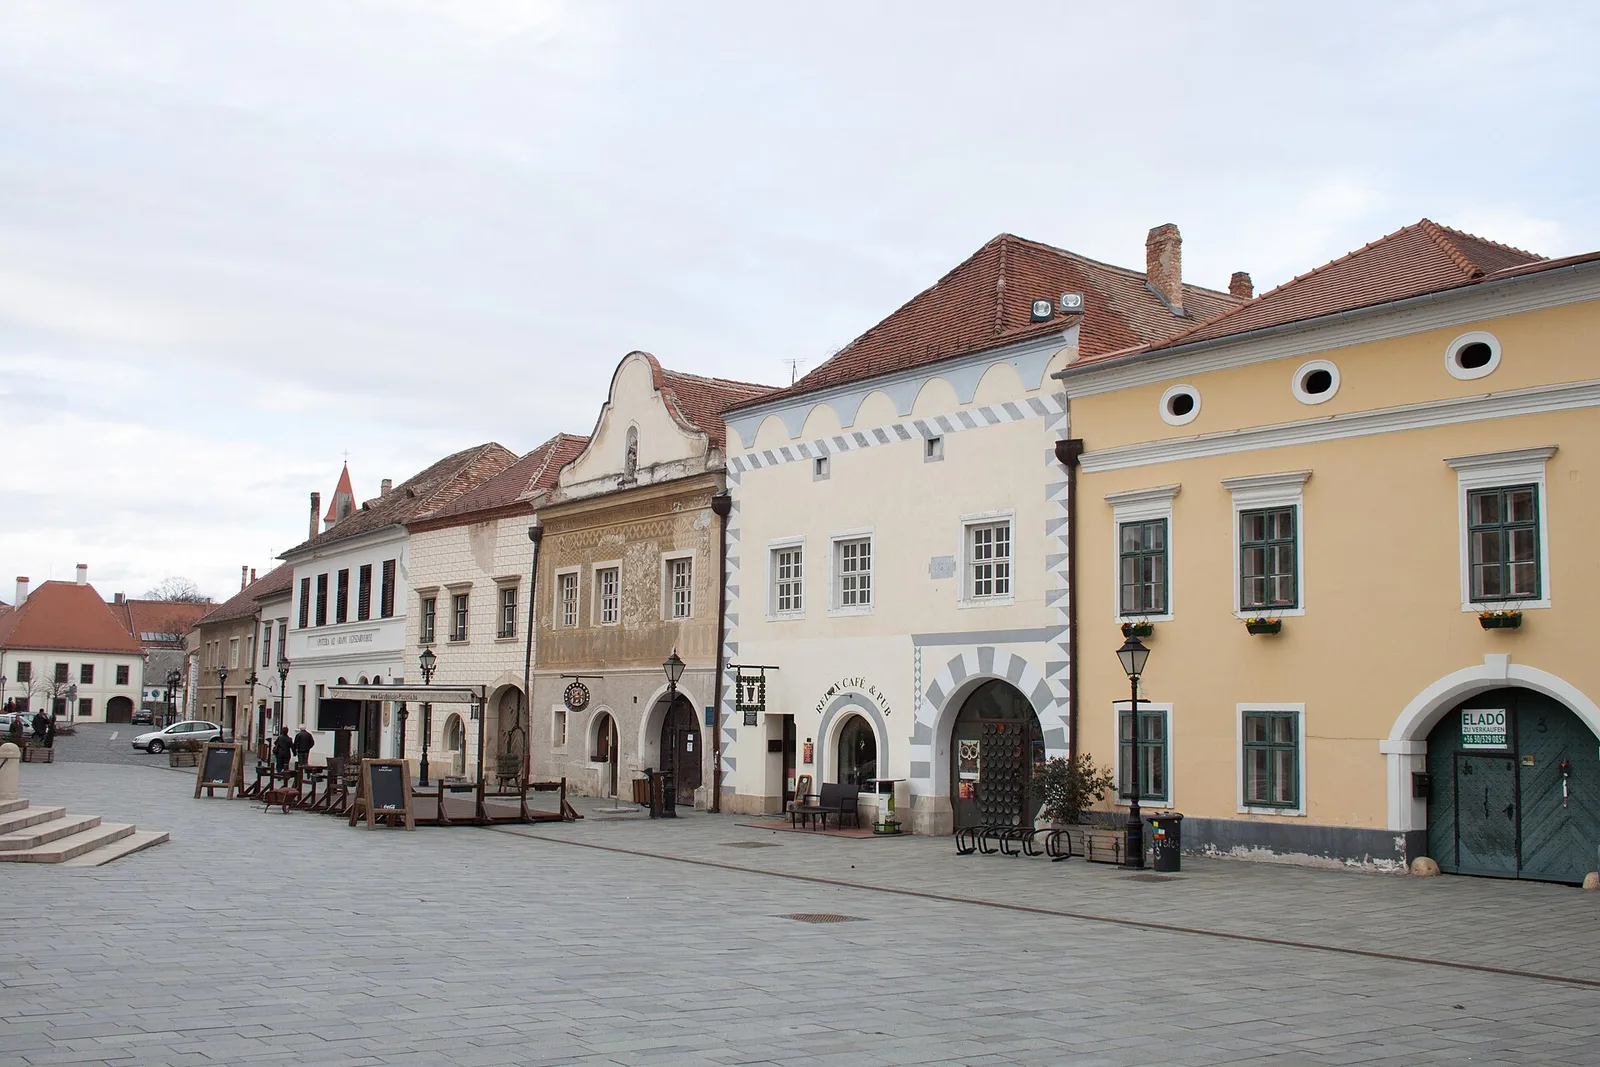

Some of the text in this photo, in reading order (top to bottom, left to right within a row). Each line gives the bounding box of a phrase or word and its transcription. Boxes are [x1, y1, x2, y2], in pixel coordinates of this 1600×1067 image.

[816, 677, 892, 717] RELX CAFÉ & PUB
[1463, 710, 1505, 726] ELADÓ
